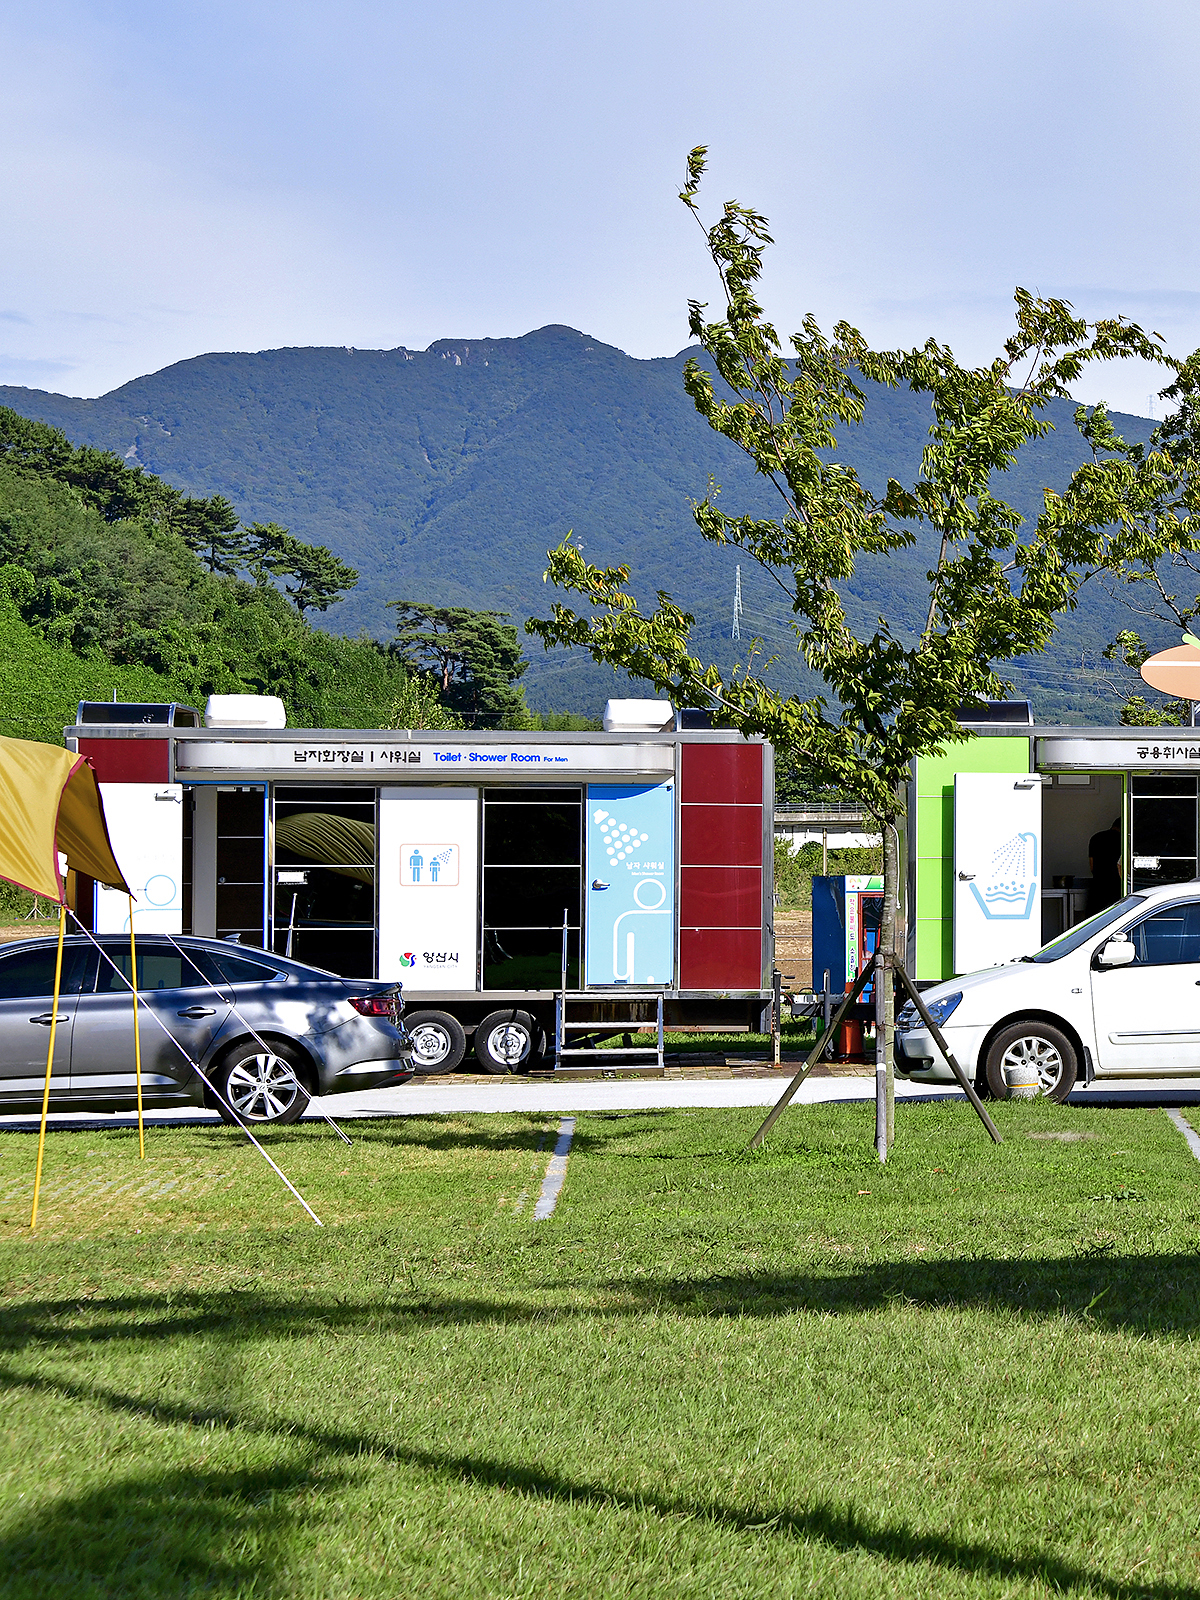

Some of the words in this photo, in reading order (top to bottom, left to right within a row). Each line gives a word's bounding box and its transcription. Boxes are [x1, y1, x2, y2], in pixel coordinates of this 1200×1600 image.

[294, 749, 364, 763] 남자화장실
[380, 750, 421, 763] 샤워실
[433, 752, 462, 762] Toilet
[468, 752, 508, 762] Shower
[510, 752, 541, 762] Room
[1136, 746, 1200, 759] 공용취사실
[626, 862, 641, 870] 남자
[422, 952, 459, 963] 양산시
